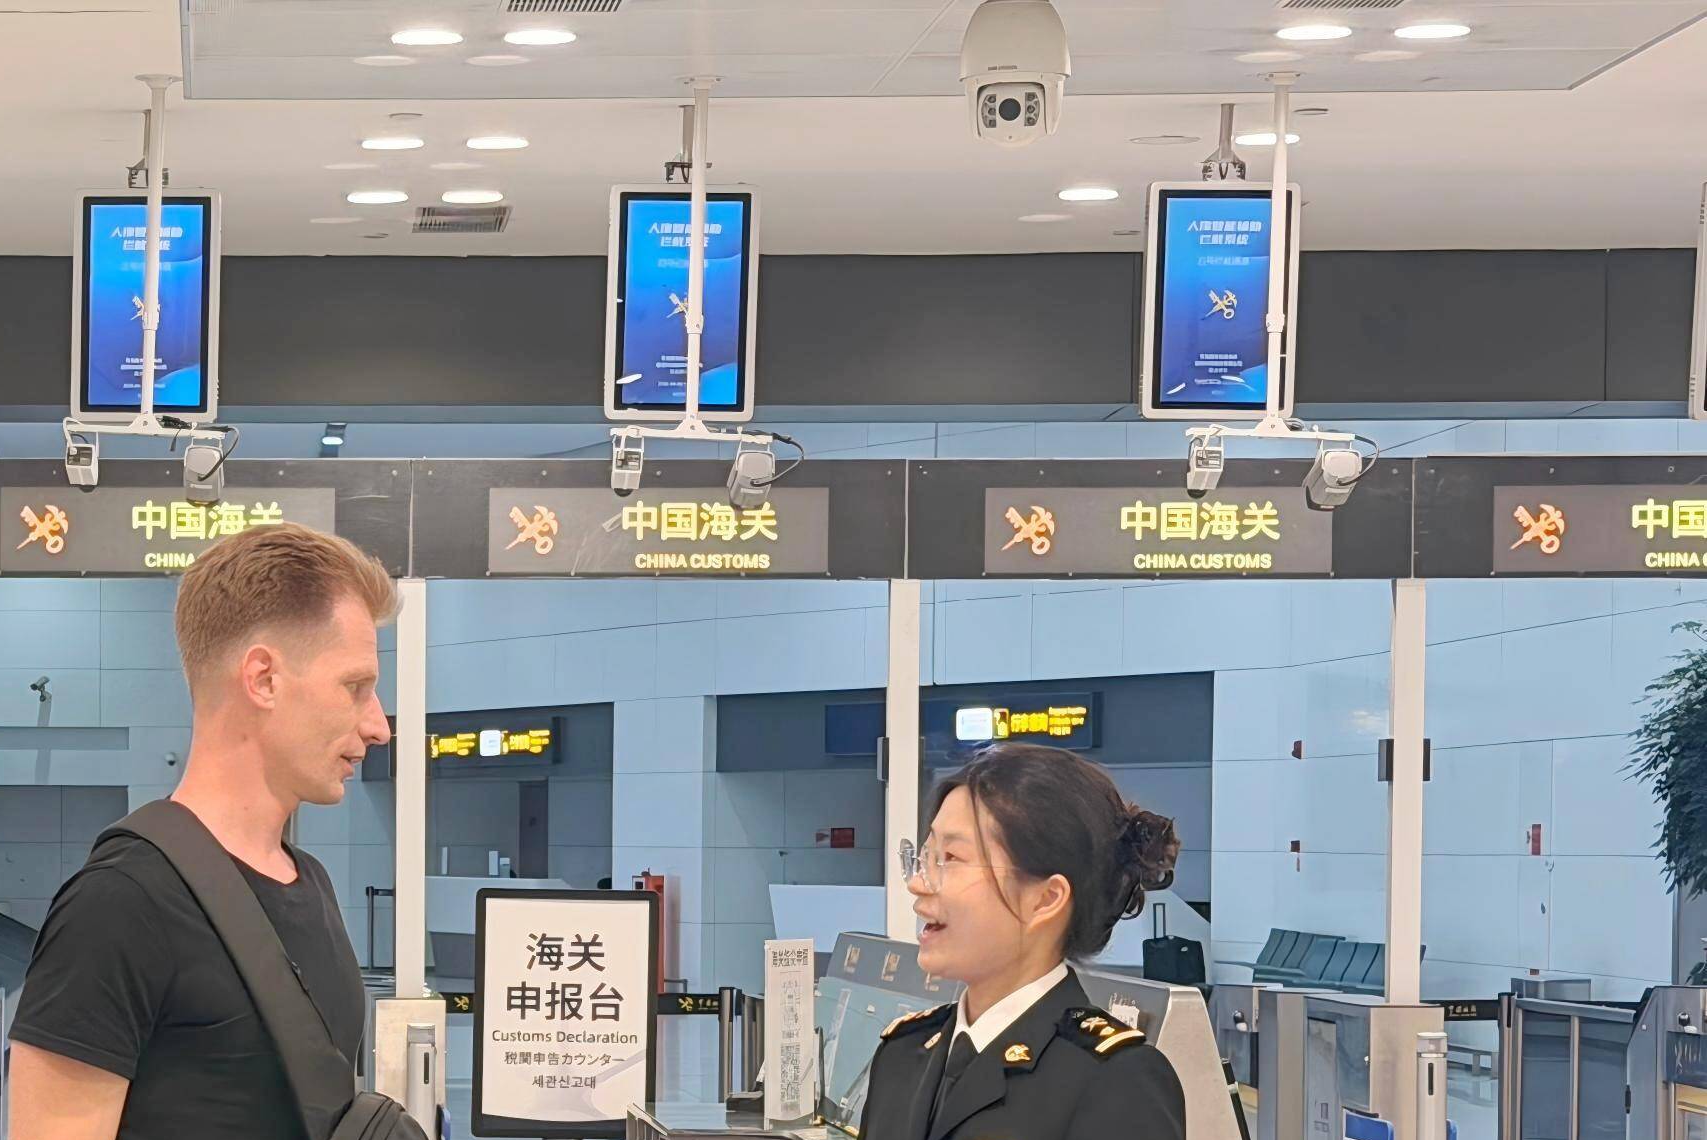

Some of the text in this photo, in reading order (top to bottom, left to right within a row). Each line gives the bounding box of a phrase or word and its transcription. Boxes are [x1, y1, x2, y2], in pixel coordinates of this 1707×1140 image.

[132, 500, 283, 540] 中国海关
[622, 500, 778, 541] 中国海关
[1120, 500, 1280, 541] 中国海关
[635, 553, 770, 569] CHINA CUSTOMS
[1133, 553, 1272, 569] CHINA CUSTOMS
[1644, 552, 1700, 568] CHINA
[526, 932, 606, 972] 海关
[506, 980, 624, 1022] 申报台
[491, 1029, 638, 1044] Customs Declaration
[503, 1051, 625, 1067] 税関申告カウンター
[531, 1075, 597, 1090] 세관신고대
